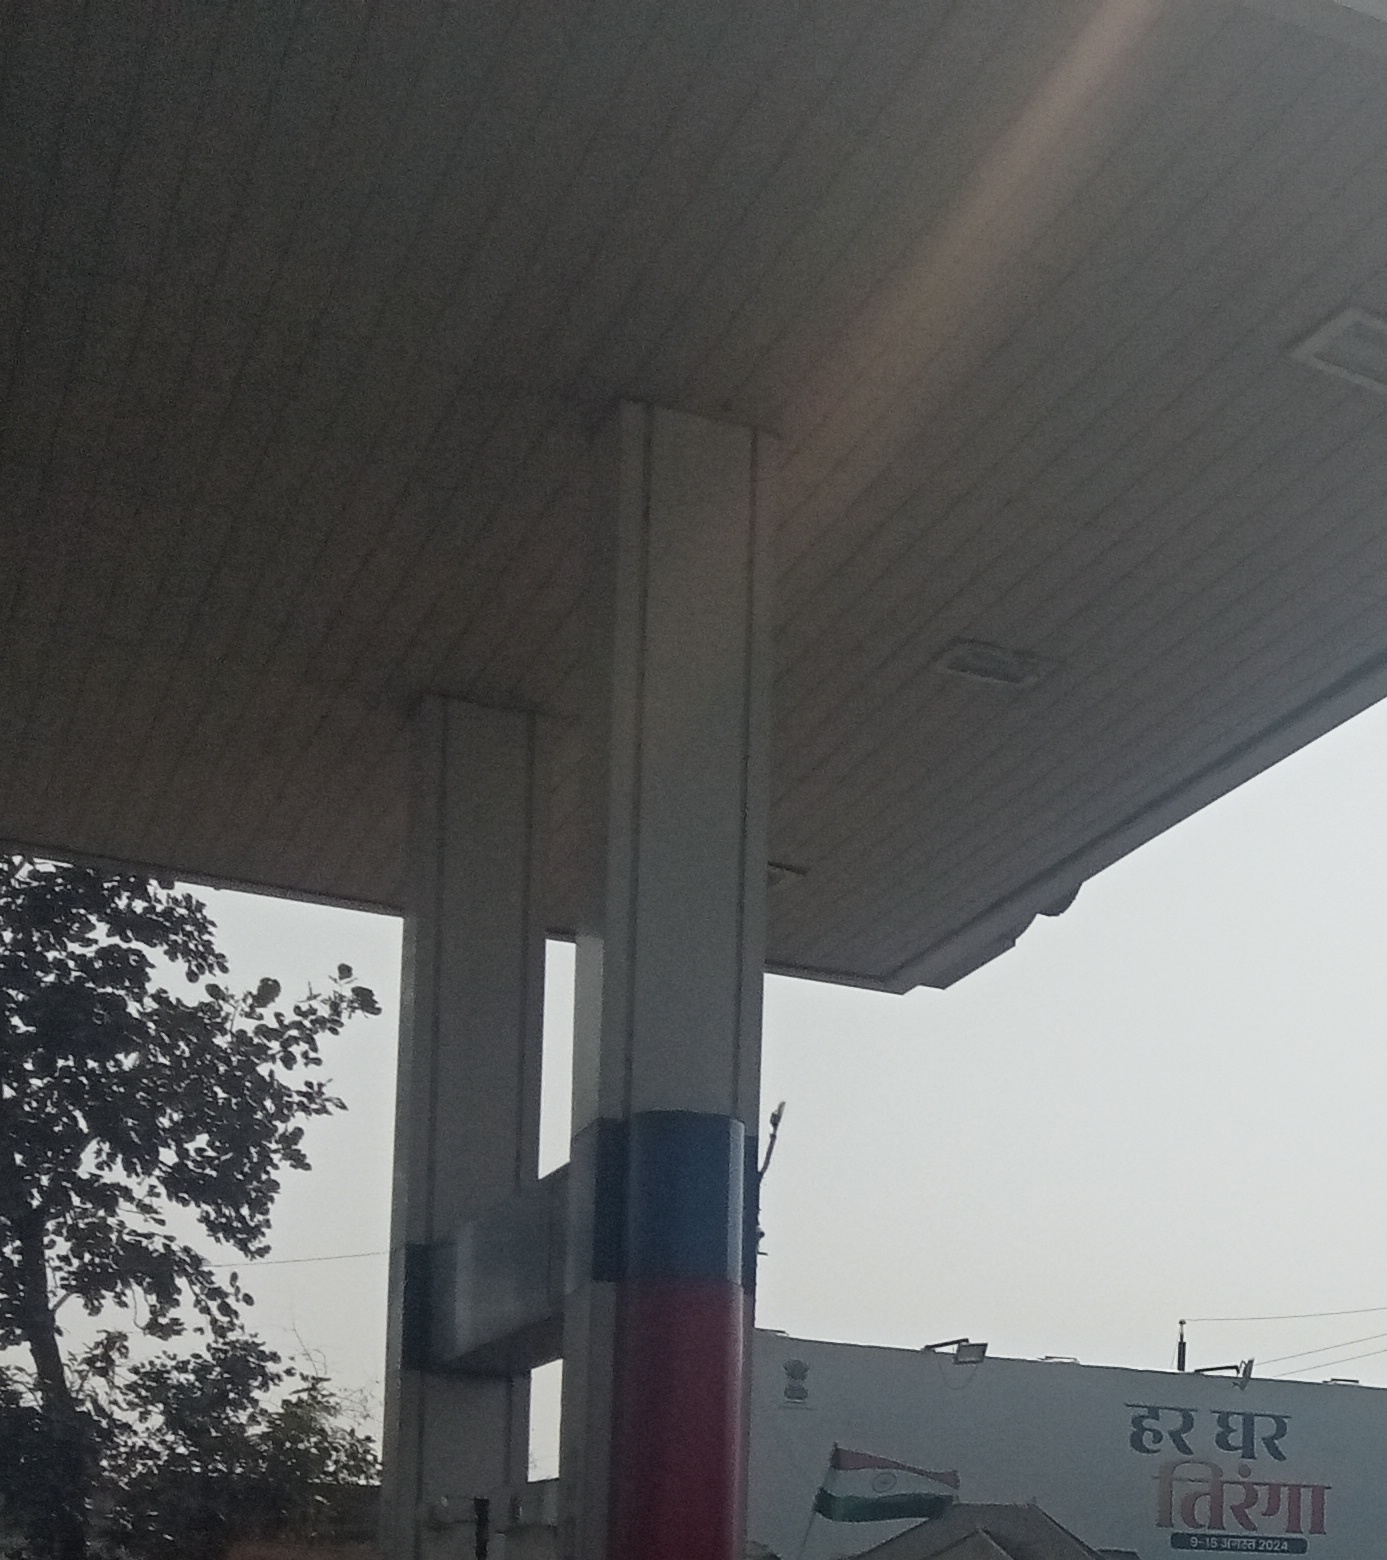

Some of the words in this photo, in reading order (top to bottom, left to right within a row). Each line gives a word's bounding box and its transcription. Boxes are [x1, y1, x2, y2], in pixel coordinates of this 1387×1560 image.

[1124, 1402, 1198, 1456] हर
[1210, 1408, 1292, 1462] घर
[1152, 1460, 1332, 1535] तिरंगा
[1258, 1539, 1288, 1551] 2024
